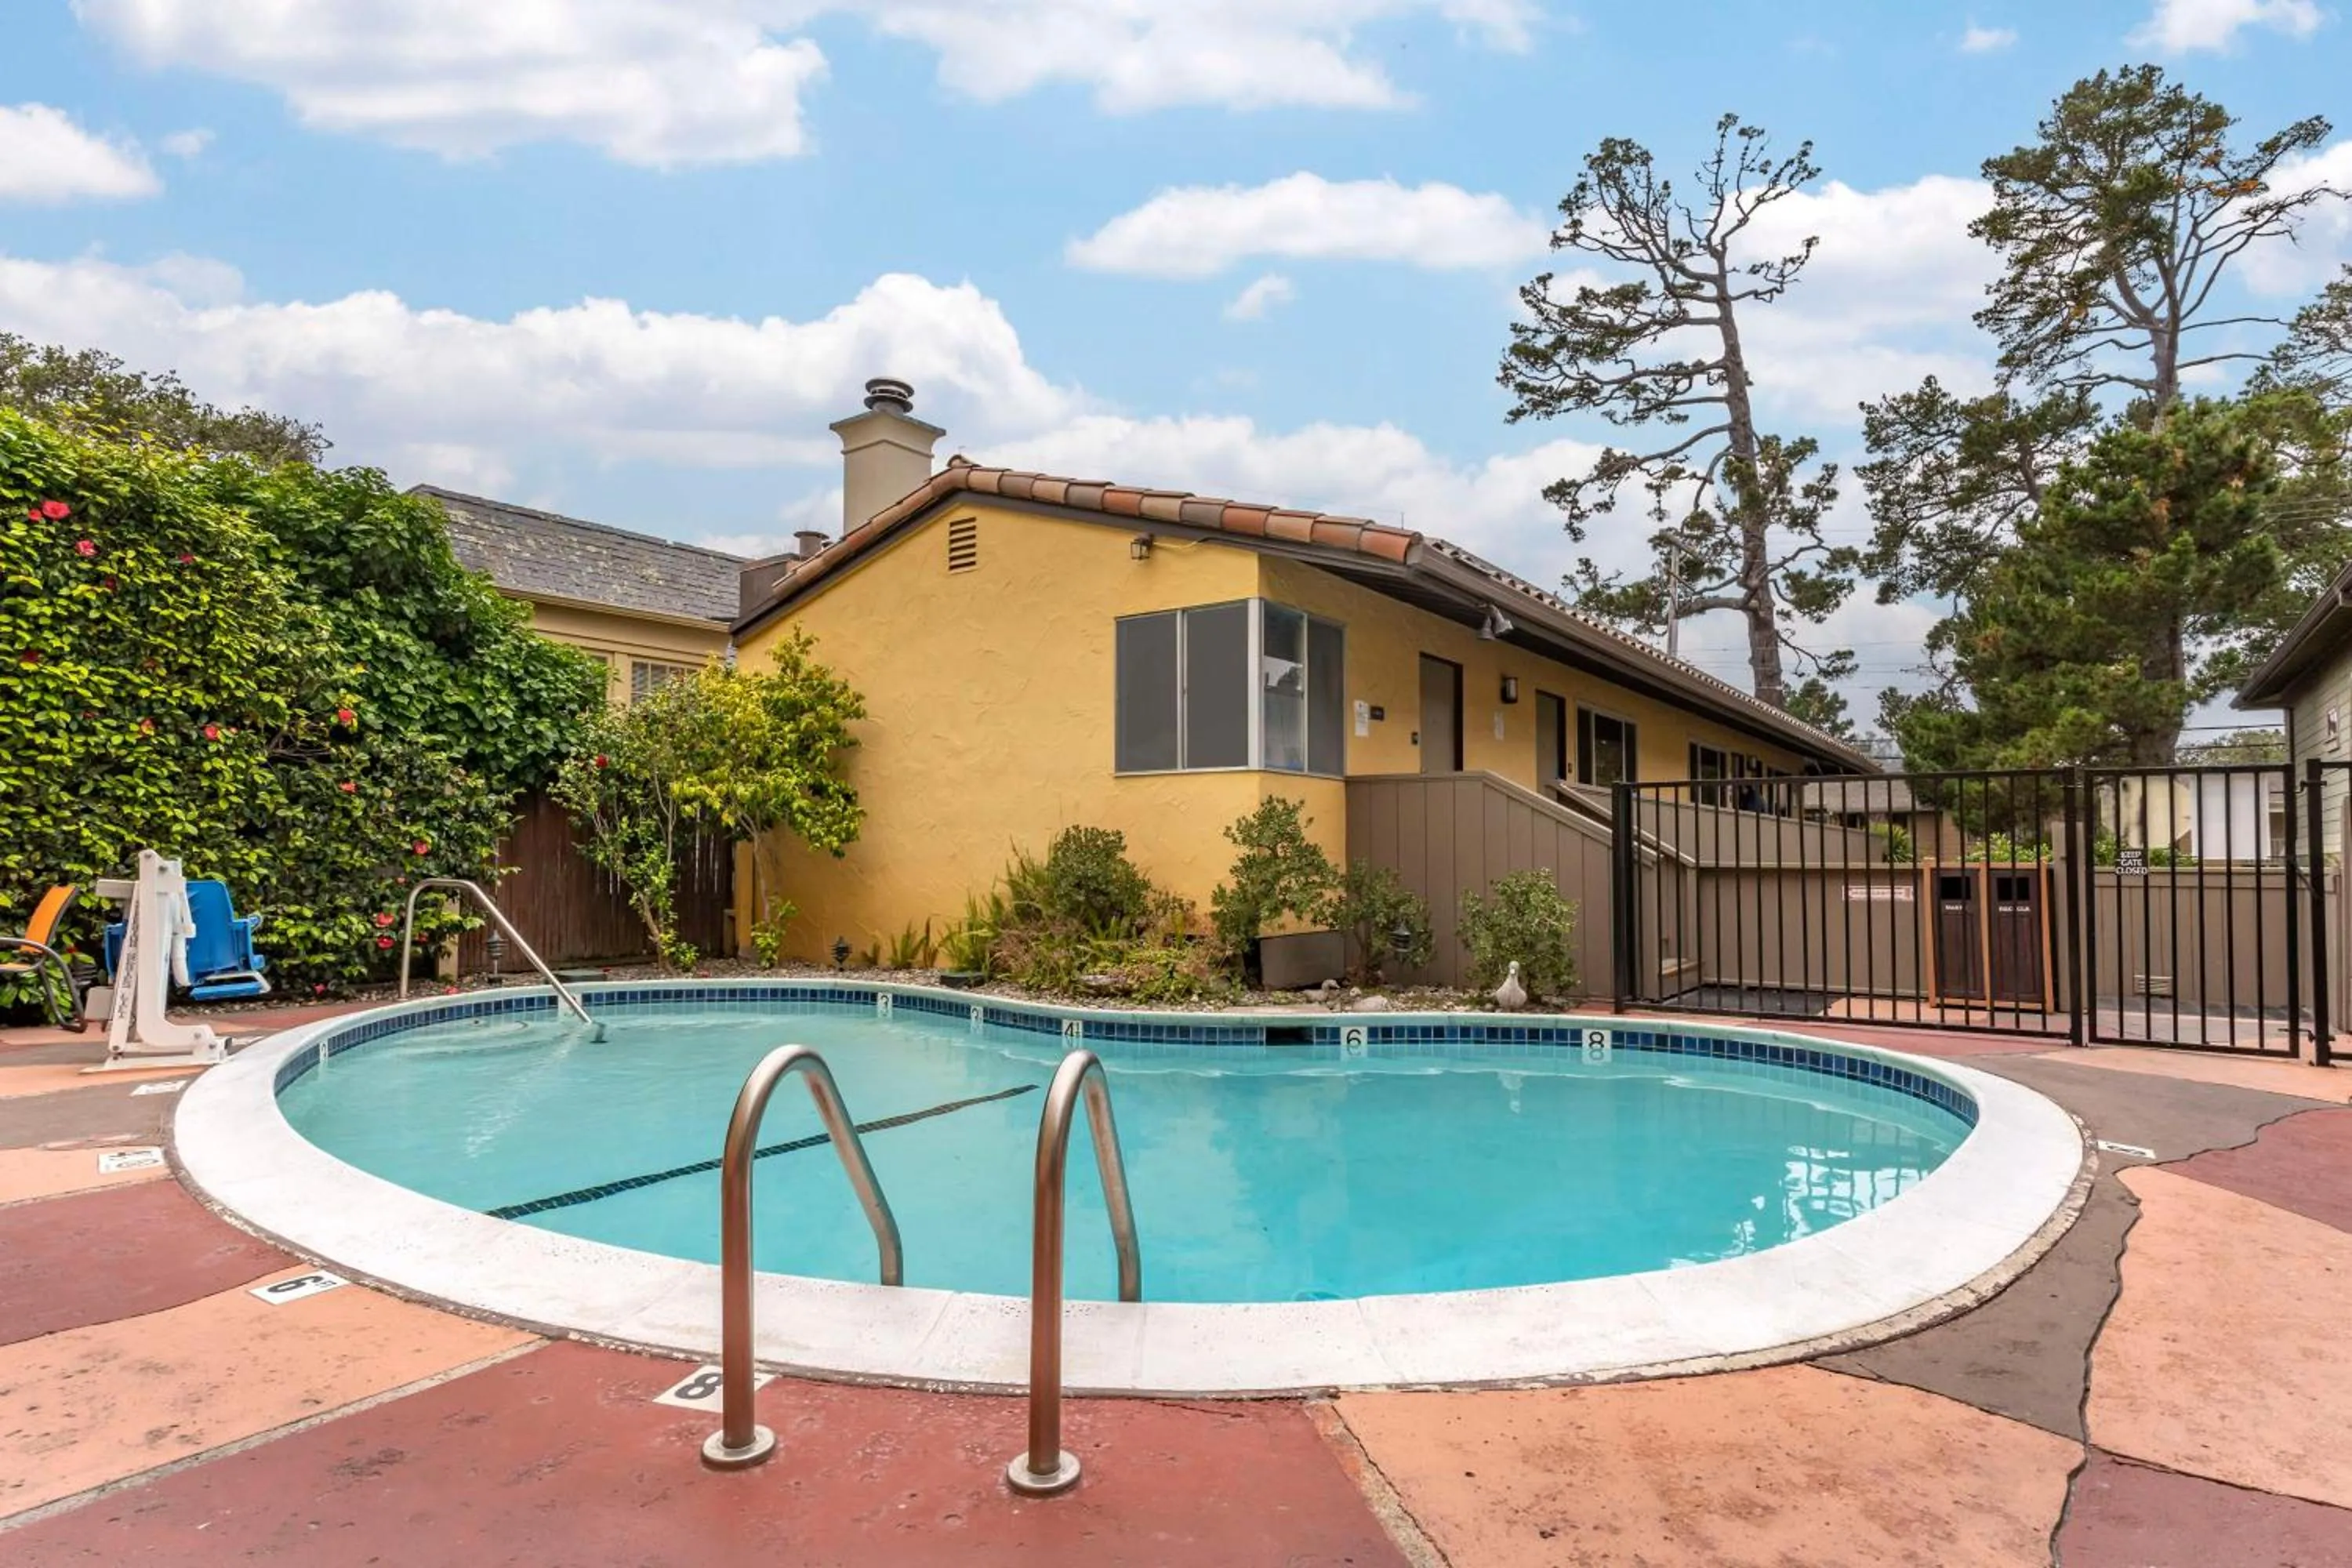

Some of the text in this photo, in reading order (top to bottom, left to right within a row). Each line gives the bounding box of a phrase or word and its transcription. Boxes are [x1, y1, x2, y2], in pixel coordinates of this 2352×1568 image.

[2115, 866, 2148, 875] CLOSED
[1346, 1029, 1362, 1048] 6
[1588, 1031, 1605, 1051] 8
[267, 1276, 325, 1293] 6
[674, 1372, 724, 1400] 8
